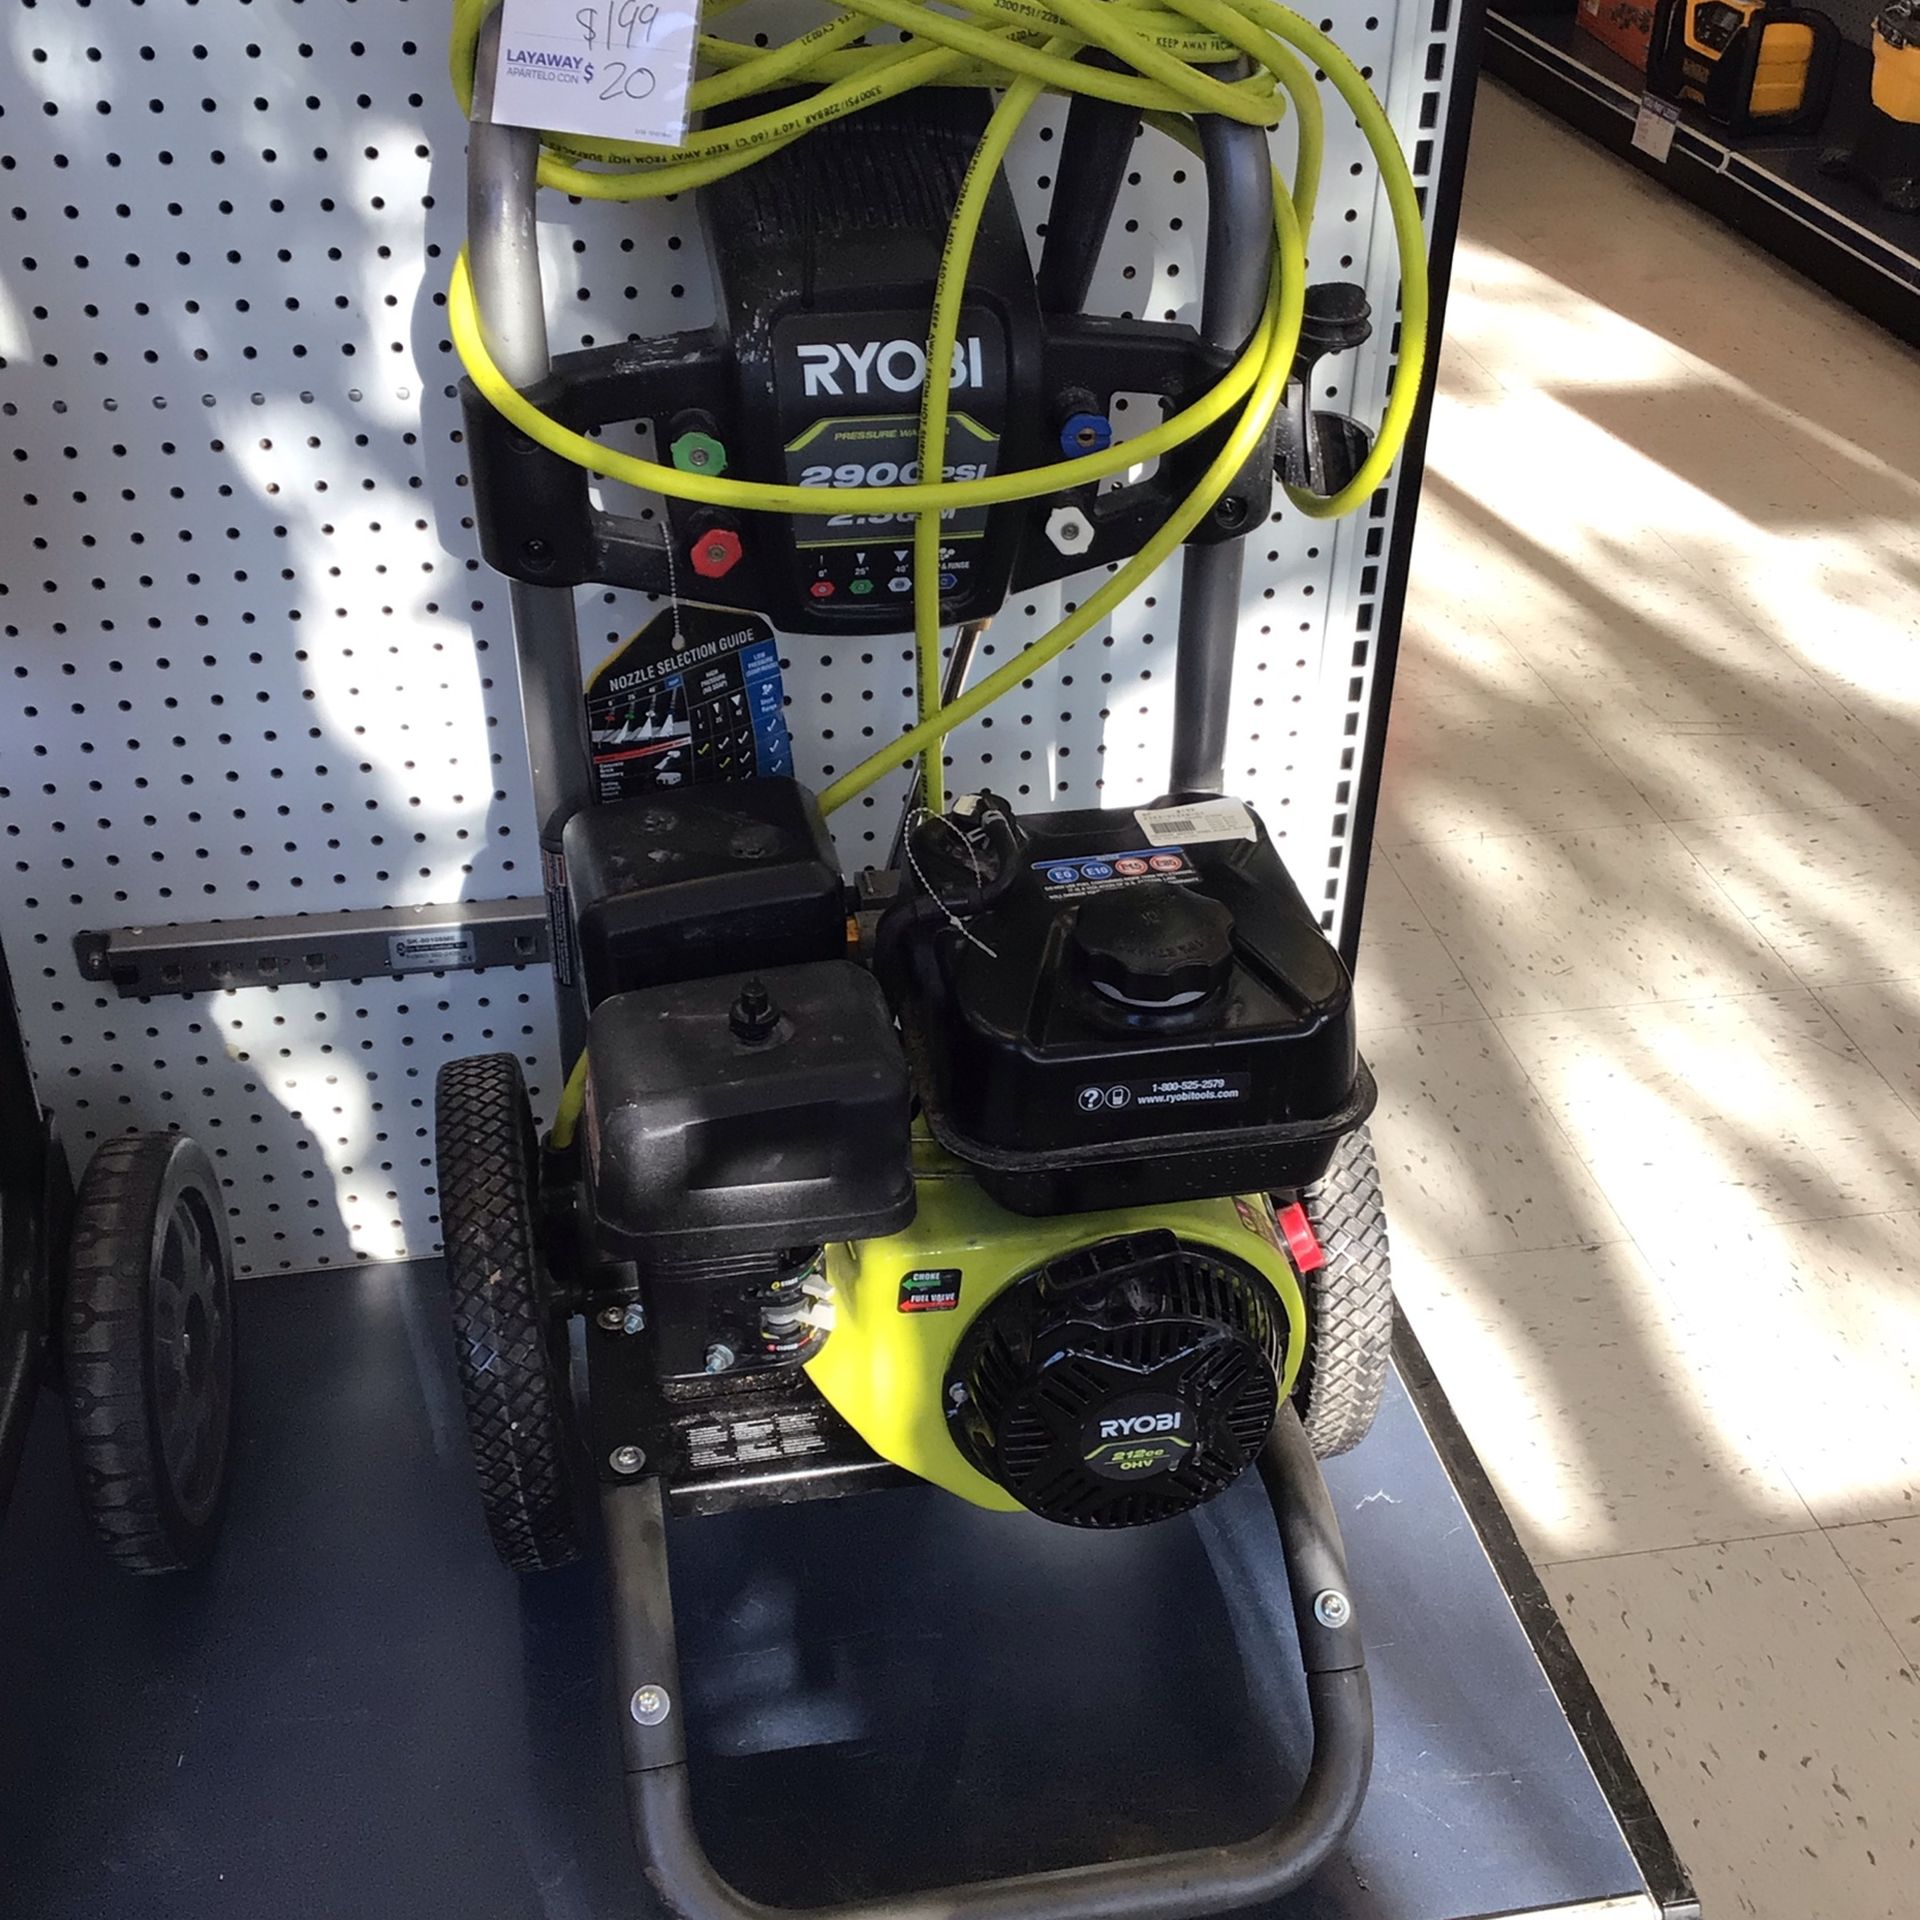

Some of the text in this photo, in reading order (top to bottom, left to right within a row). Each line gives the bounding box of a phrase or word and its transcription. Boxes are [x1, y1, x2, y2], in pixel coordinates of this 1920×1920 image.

[1156, 37, 1179, 49] KEEP
[506, 49, 583, 70] LAYAWAY
[507, 67, 579, 84] APARTELO CON
[600, 62, 656, 101] 20
[670, 149, 701, 162] AWAY
[704, 143, 730, 156] KEEP
[608, 154, 632, 165] HOT
[635, 154, 667, 164] FROM
[609, 665, 655, 692] NOZZLE
[656, 642, 717, 676] SELECTION
[719, 627, 755, 652] GUIDE
[1152, 1079, 1225, 1093] 1-800-525-2579
[1137, 1088, 1239, 1105] www.ryobitools.com
[1100, 1411, 1181, 1438] RYOBI
[1120, 1459, 1153, 1470] OHV
